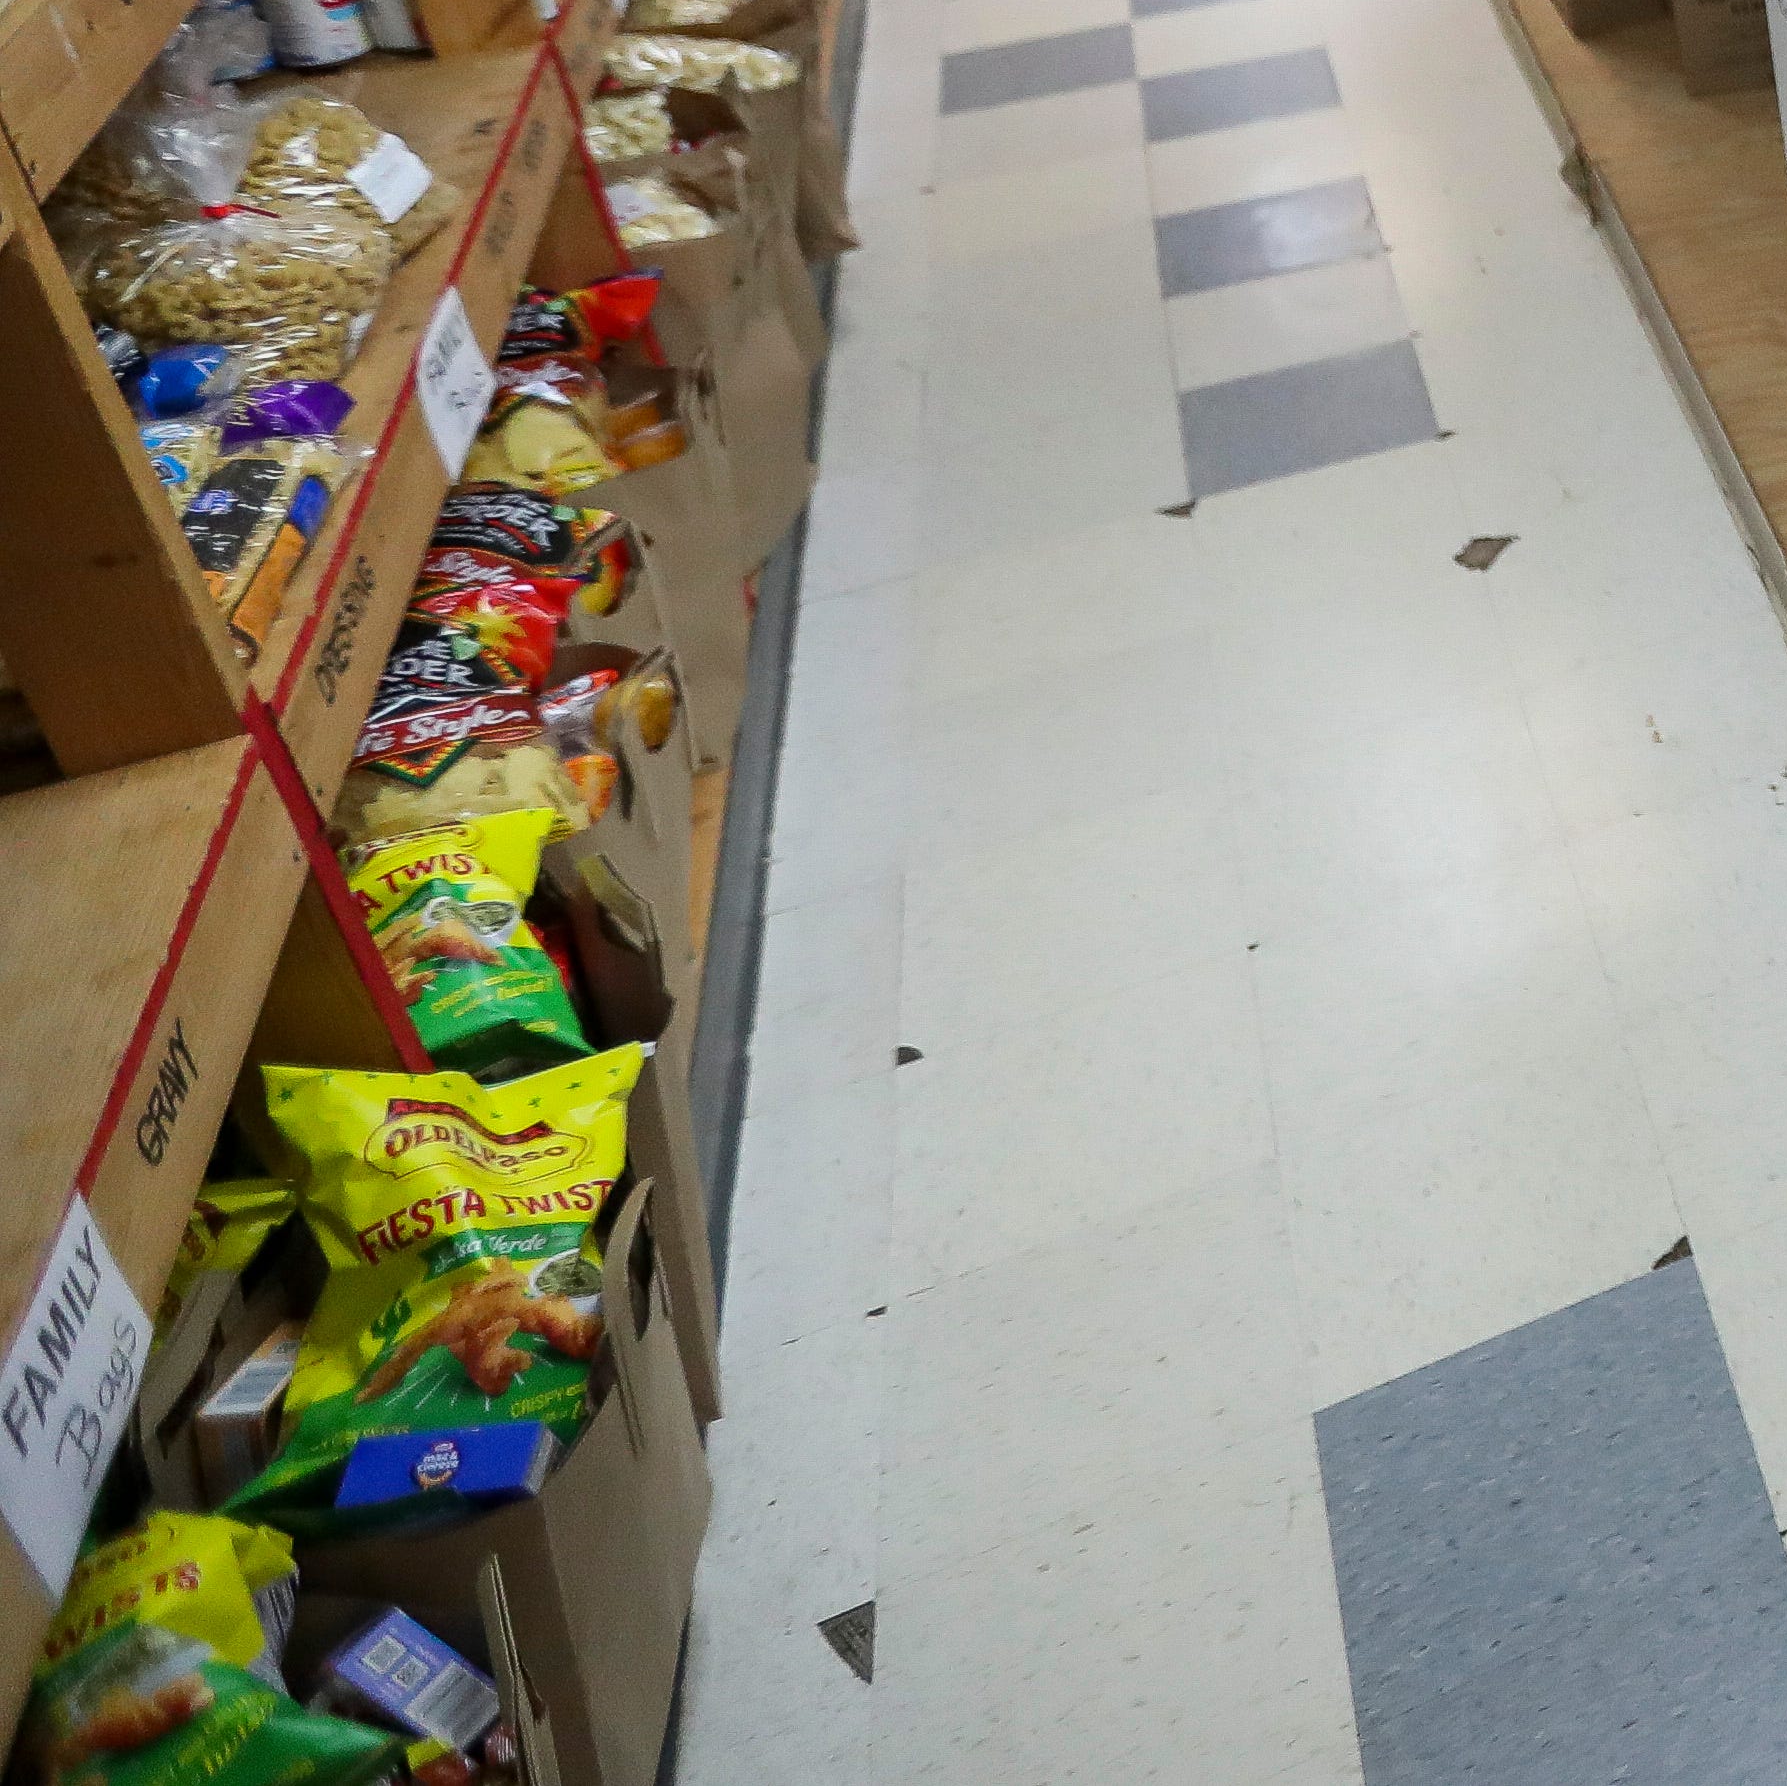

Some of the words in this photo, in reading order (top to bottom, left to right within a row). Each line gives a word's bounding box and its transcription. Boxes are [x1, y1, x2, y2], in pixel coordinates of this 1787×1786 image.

[135, 1019, 203, 1169] GRAVY
[384, 1124, 451, 1159] OLD
[356, 1187, 486, 1267] FIESTA
[488, 1232, 548, 1254] Verde
[3, 1226, 109, 1460] FAMILY
[55, 1320, 138, 1492] Bags
